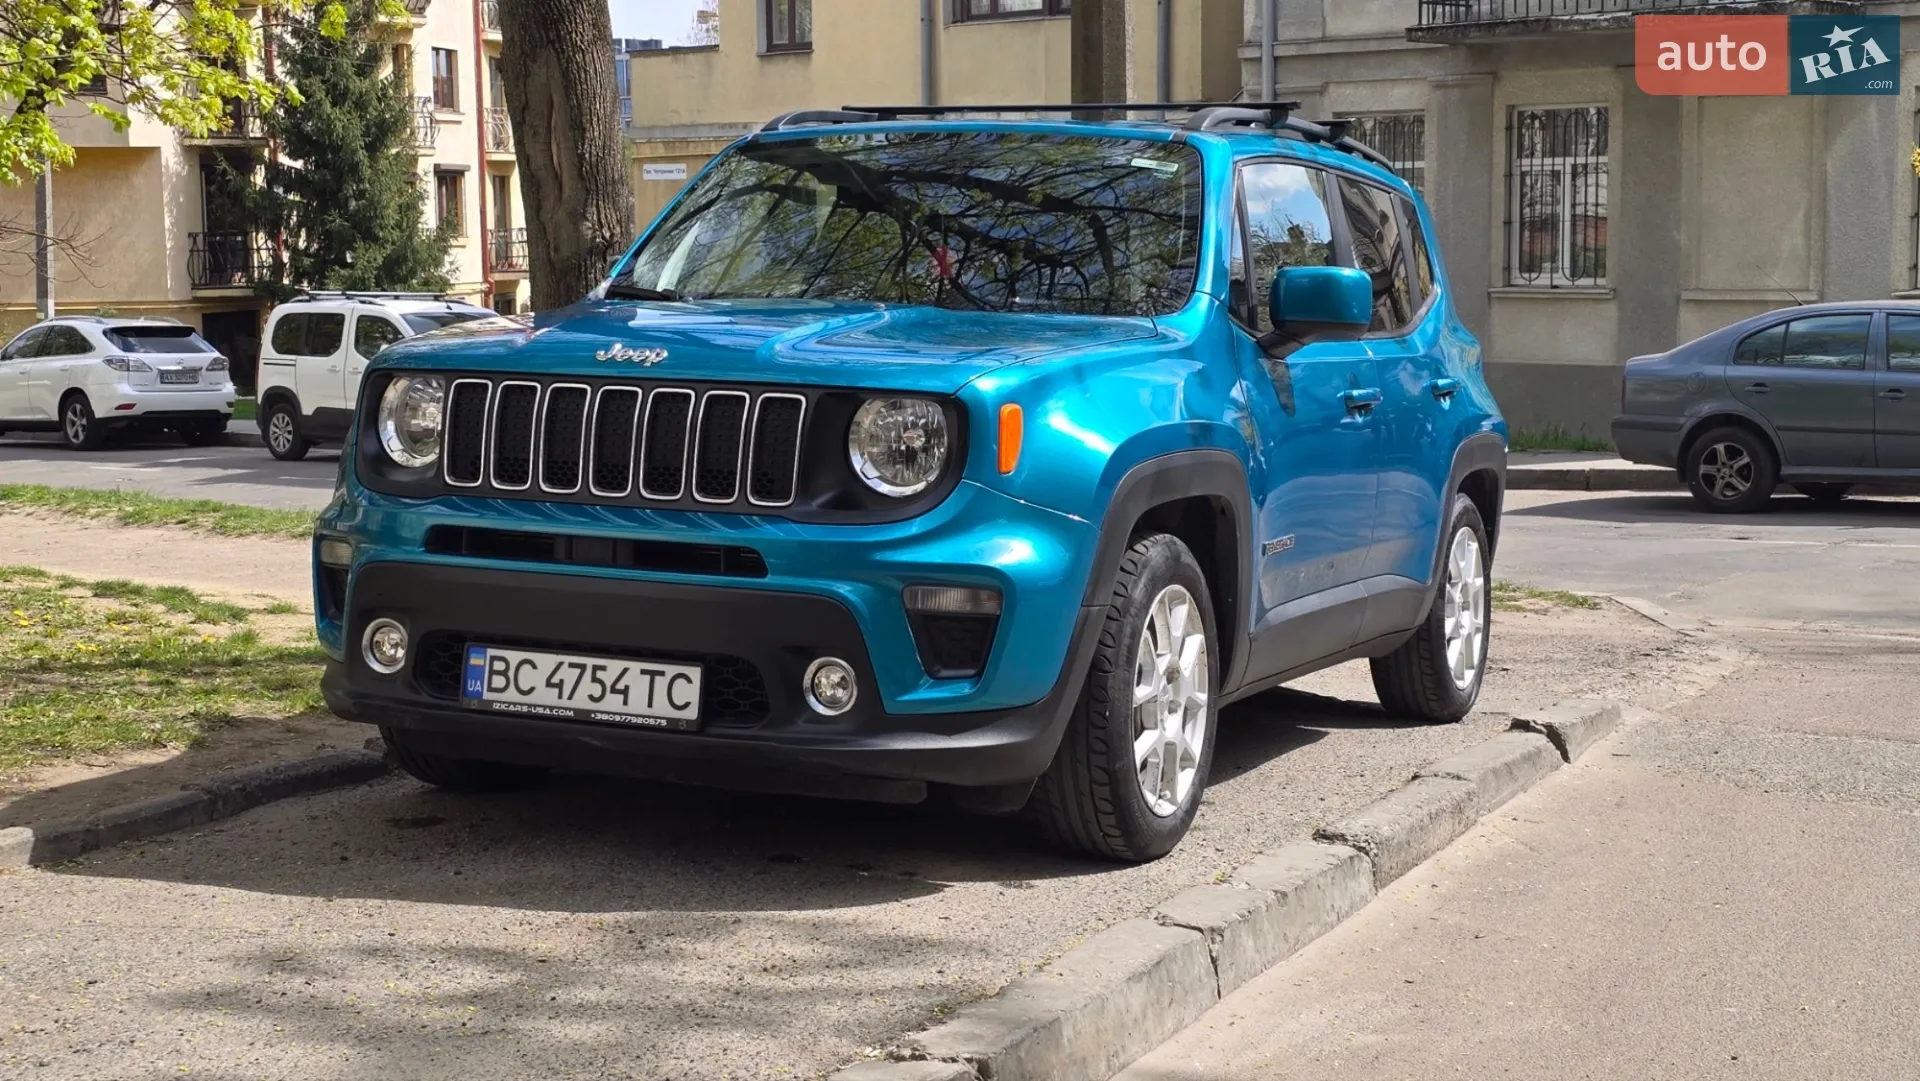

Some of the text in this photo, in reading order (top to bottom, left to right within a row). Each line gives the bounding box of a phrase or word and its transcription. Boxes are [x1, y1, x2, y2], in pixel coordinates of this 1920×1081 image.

[595, 342, 669, 367] Jeep
[467, 679, 482, 693] UA
[486, 654, 694, 711] BC 4754 TC
[492, 702, 575, 717] IZICARS-USA.COM
